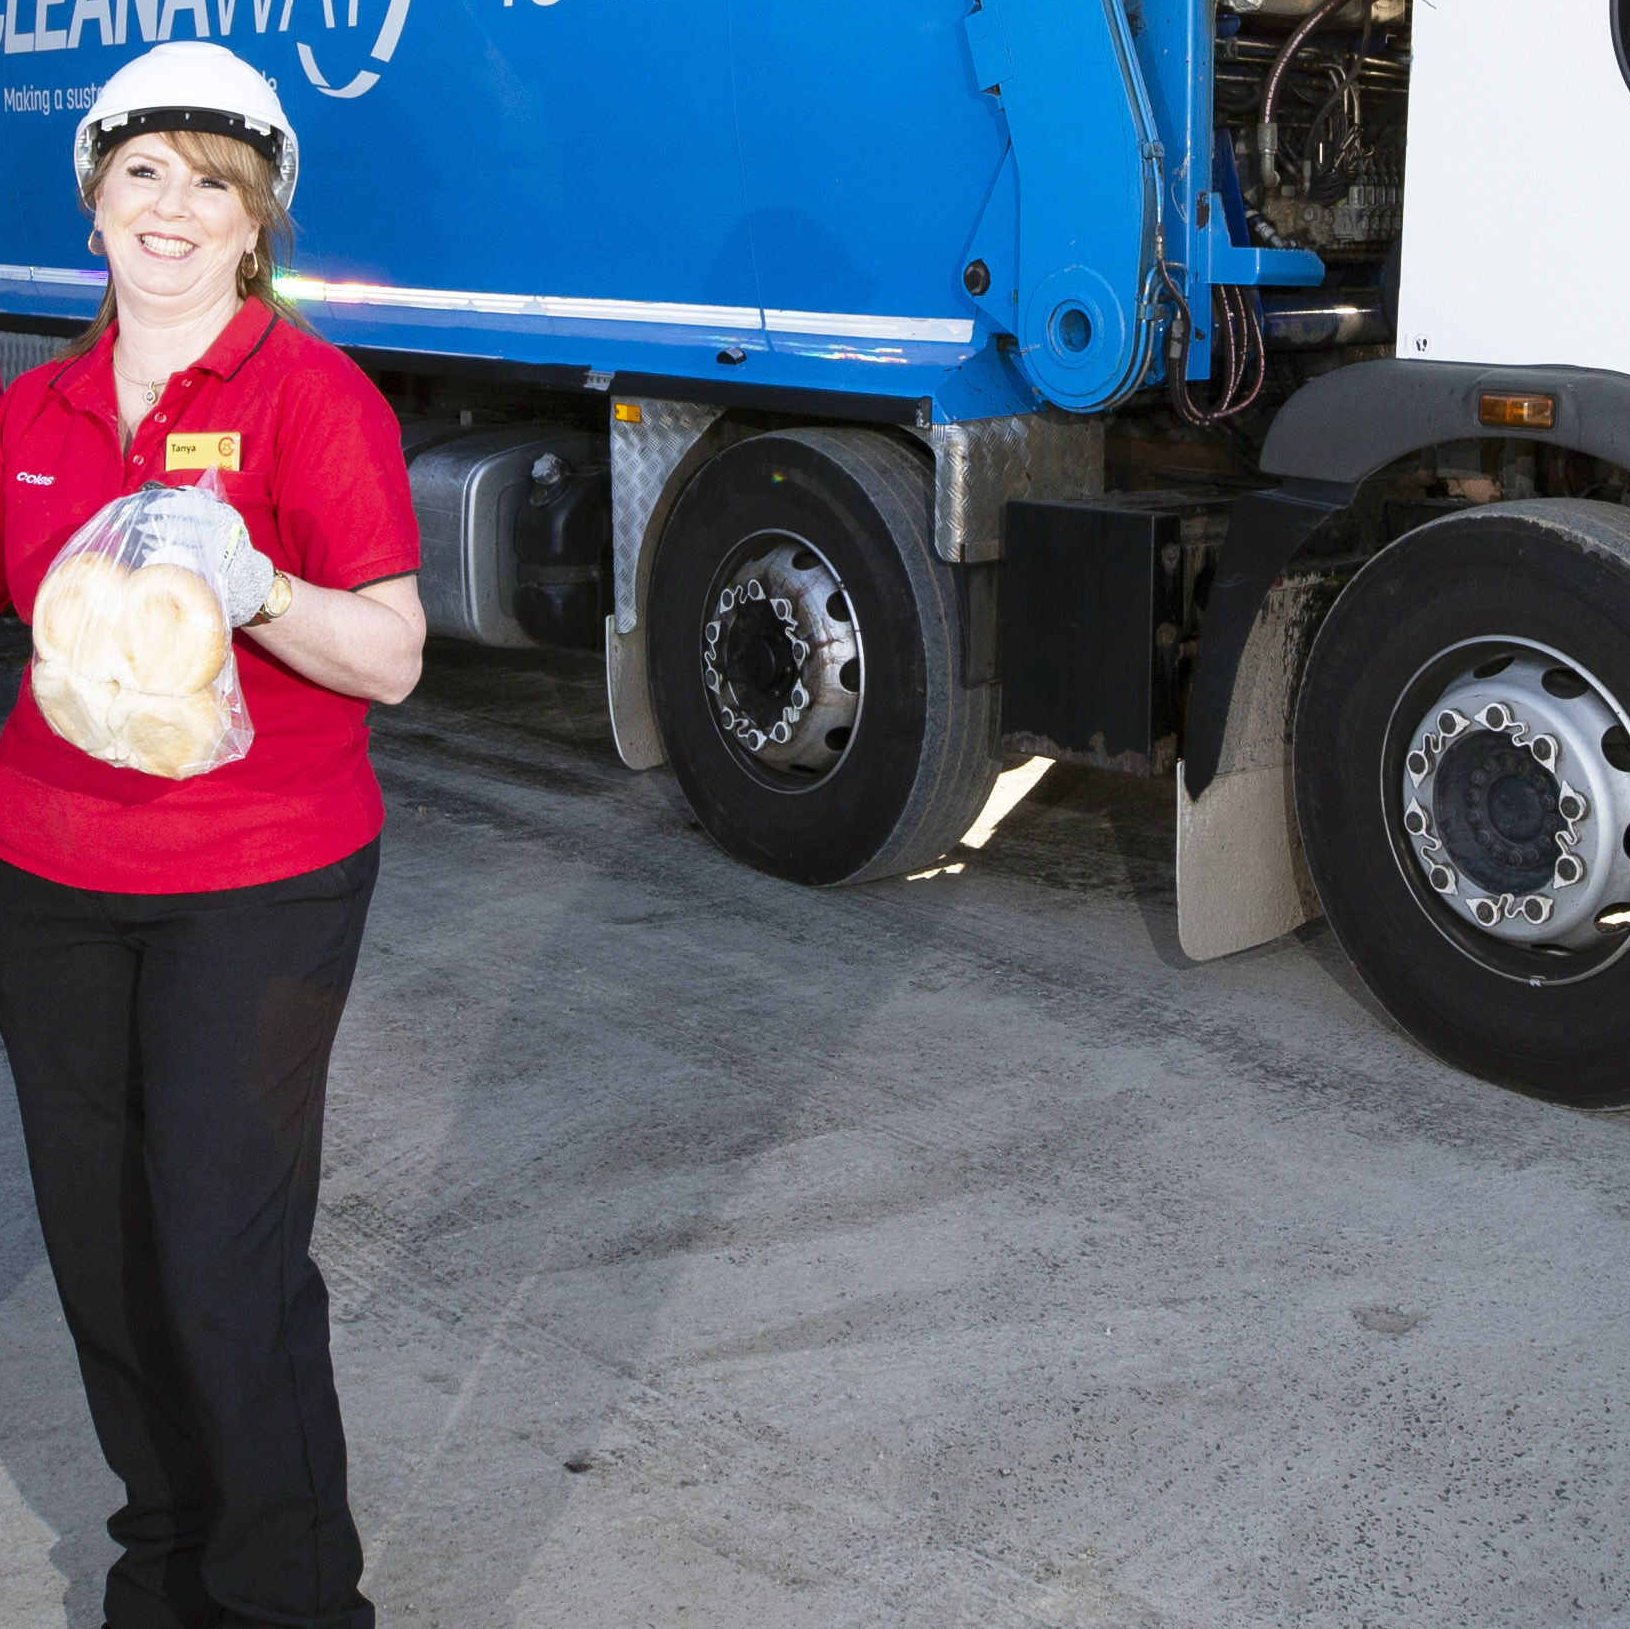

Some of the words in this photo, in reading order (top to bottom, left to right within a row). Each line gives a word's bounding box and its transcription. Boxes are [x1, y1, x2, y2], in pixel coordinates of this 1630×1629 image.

[4, 85, 51, 116] Making
[54, 93, 64, 111] a
[171, 444, 197, 455] Tanya
